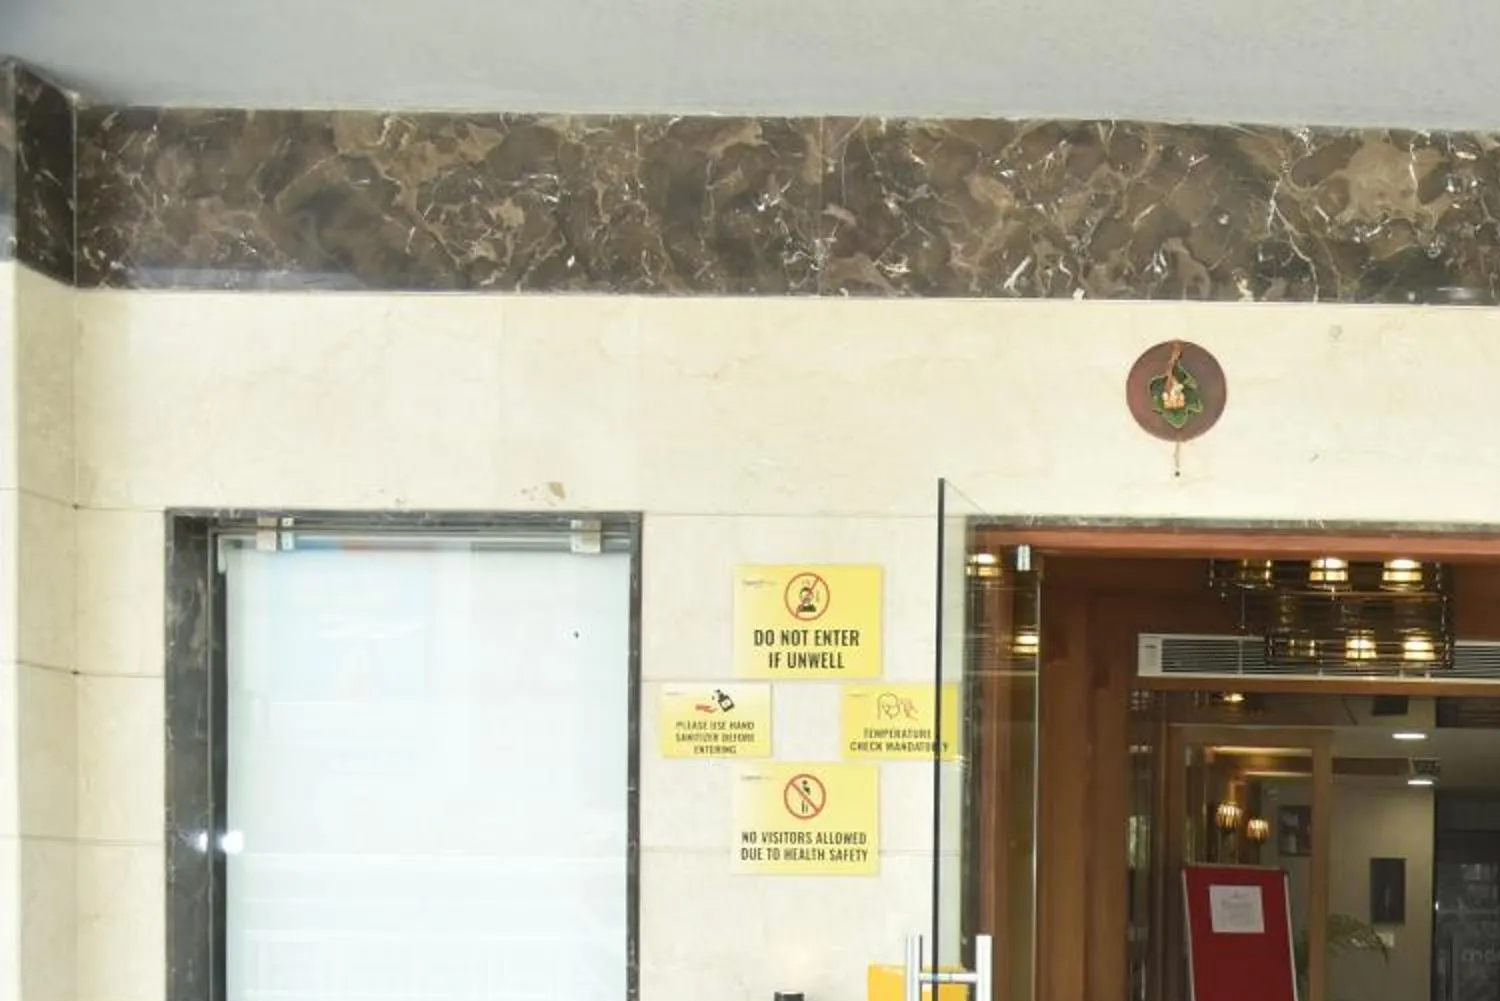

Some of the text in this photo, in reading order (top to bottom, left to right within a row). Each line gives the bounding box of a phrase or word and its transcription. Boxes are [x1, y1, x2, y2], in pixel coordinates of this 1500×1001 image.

[753, 629, 859, 646] DO NOT ENTER
[768, 651, 845, 668] IF UNWELL
[675, 720, 755, 730] PLEASE USE HAND
[675, 733, 718, 742] SANITIZER
[863, 728, 931, 738] TEMPERATURE
[693, 744, 737, 754] ENTERING
[849, 741, 883, 752] CHECK
[741, 831, 867, 844] NO VISITORS ALLOWED
[741, 847, 868, 862] DUE TO HEALTH SAFETY
